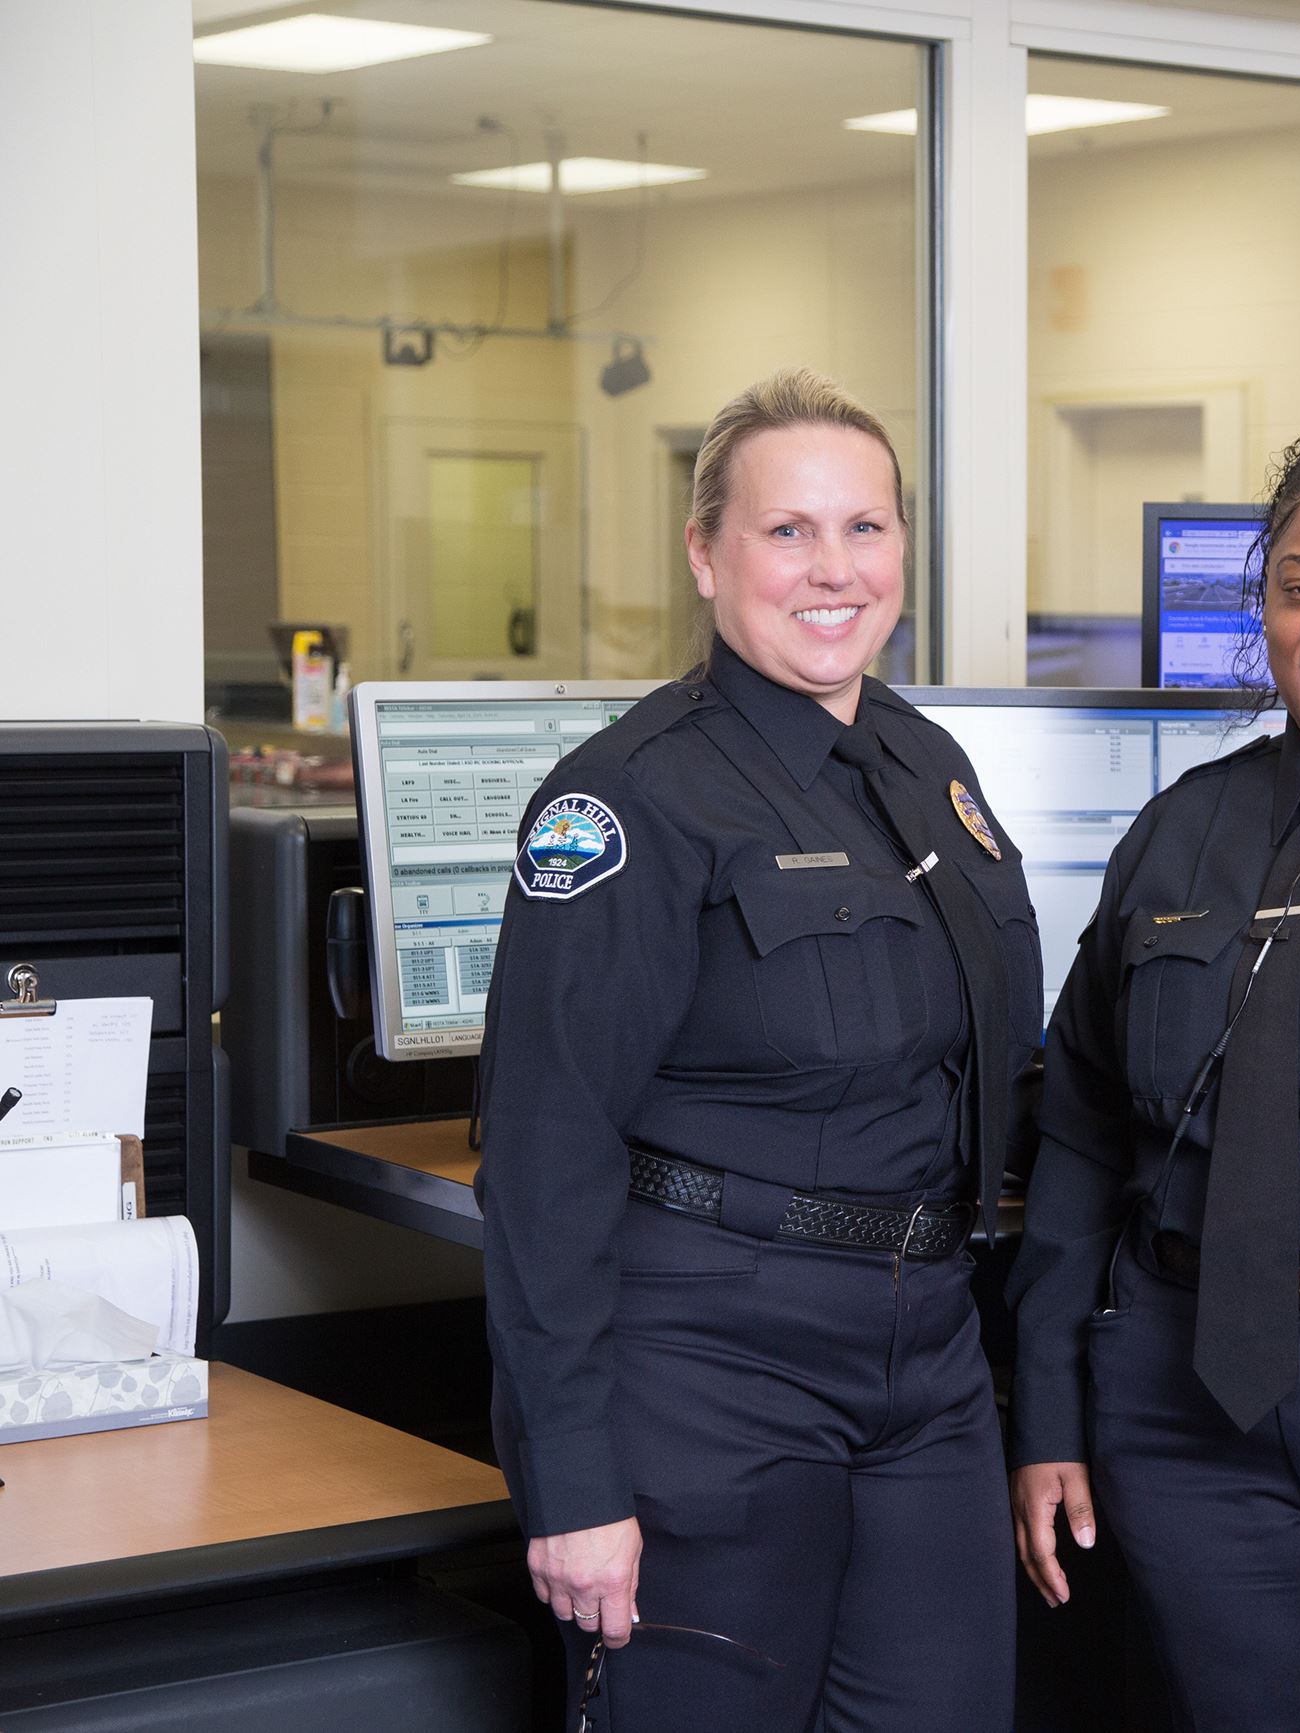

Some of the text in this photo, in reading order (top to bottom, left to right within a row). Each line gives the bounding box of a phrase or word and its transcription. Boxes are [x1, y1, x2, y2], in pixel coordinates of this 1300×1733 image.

[581, 802, 616, 842] HILL
[548, 858, 567, 867] 1924
[400, 867, 436, 876] abandoned
[437, 866, 451, 874] calls
[461, 864, 490, 873] callbacks
[531, 873, 573, 890] POLICE
[397, 1036, 443, 1046] SGNLHLL01
